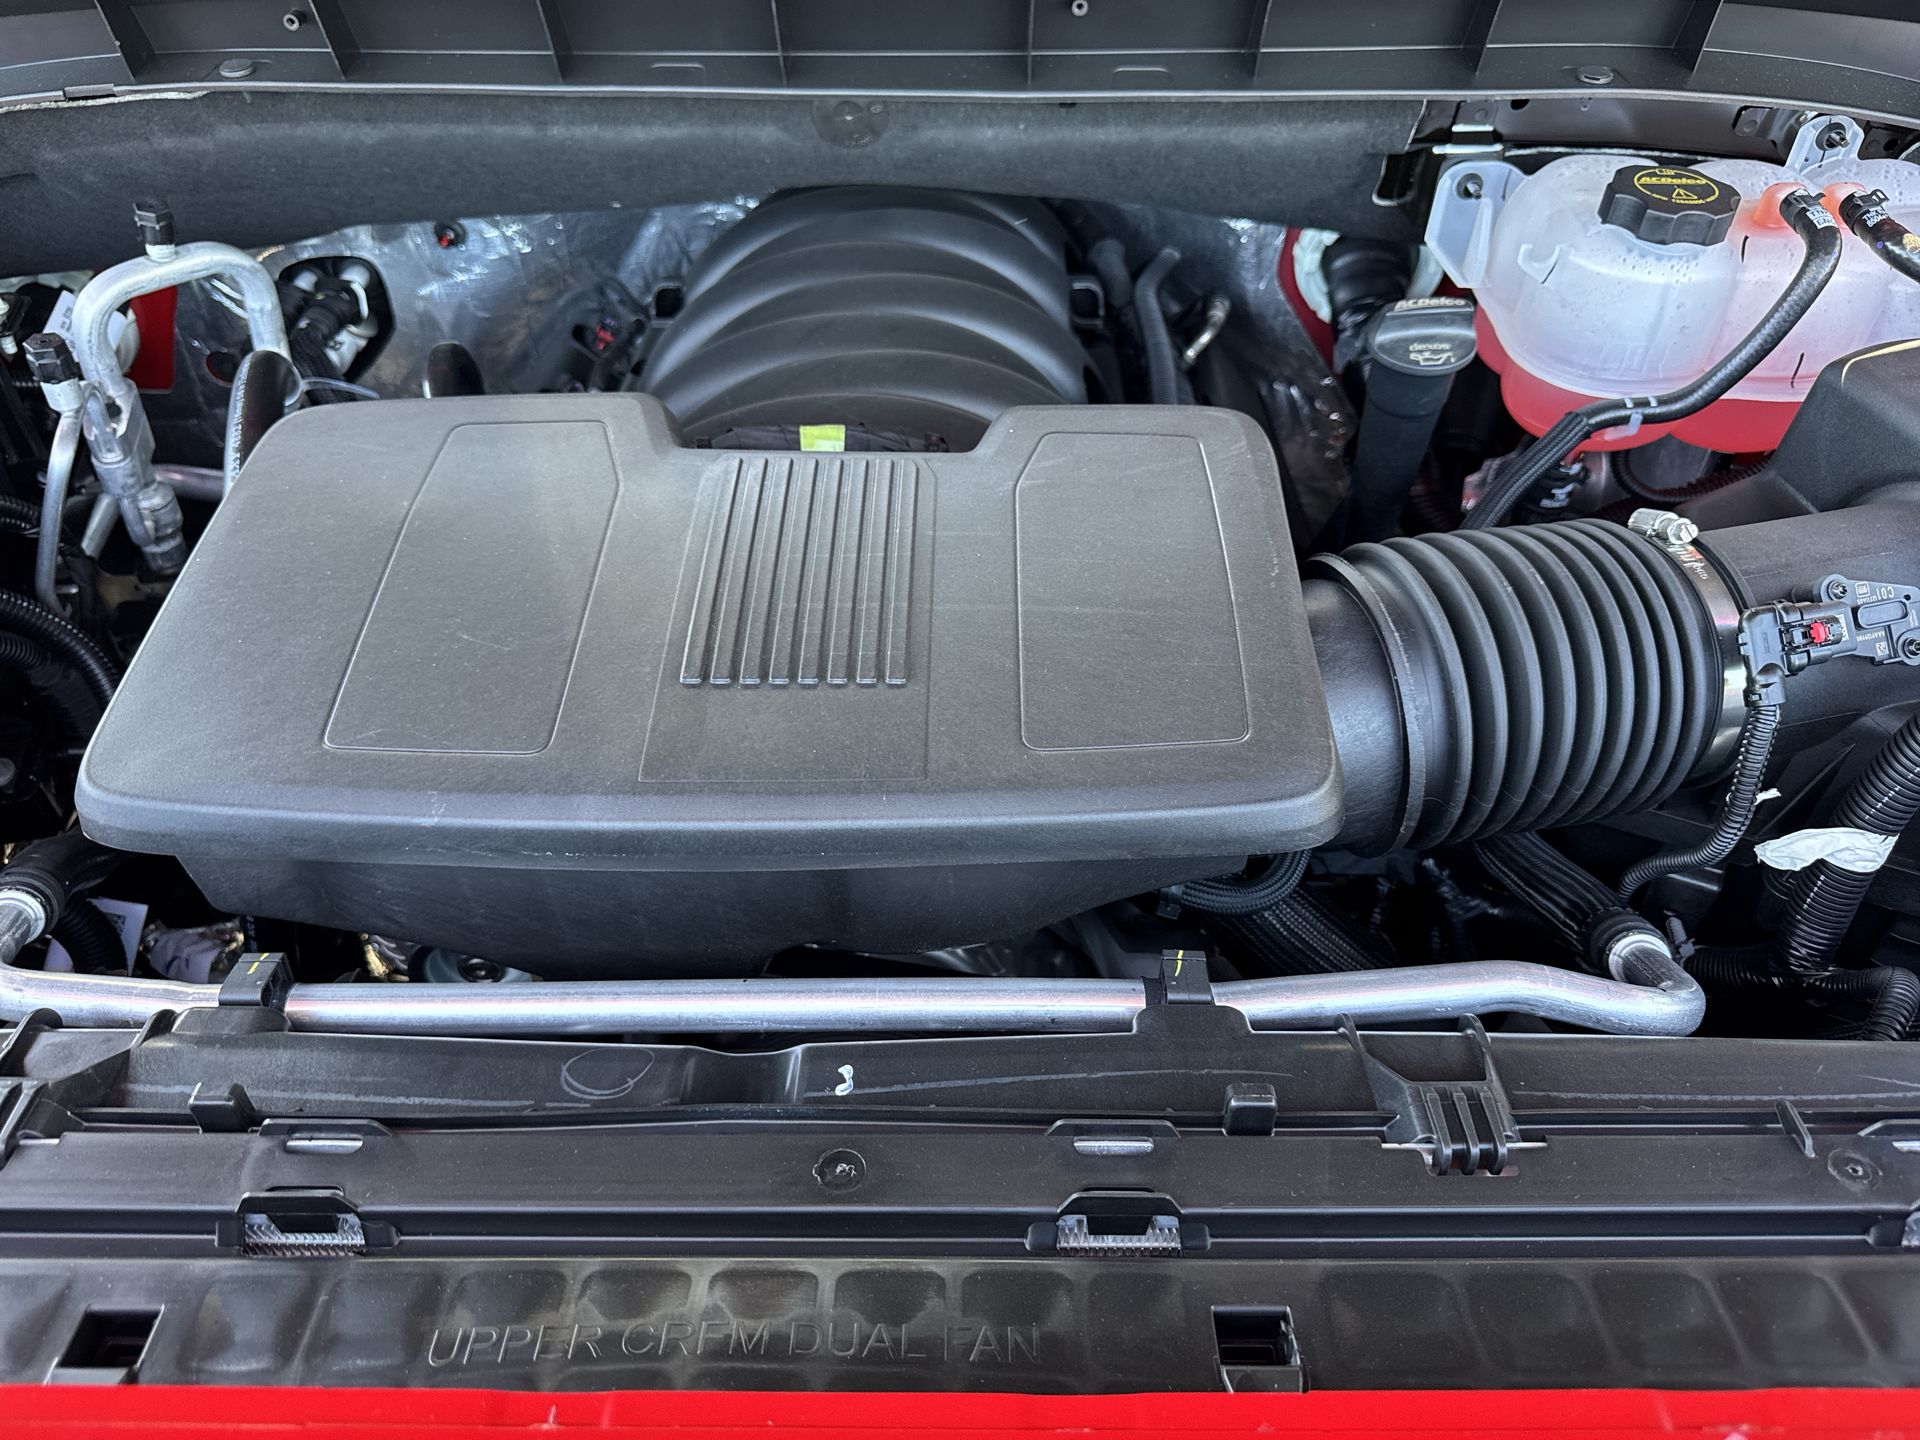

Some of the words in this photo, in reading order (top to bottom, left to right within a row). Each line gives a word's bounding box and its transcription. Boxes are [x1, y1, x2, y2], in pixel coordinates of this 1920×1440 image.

[1638, 176, 1706, 185] ACDelco
[1394, 297, 1466, 311] ACDelco
[1409, 343, 1452, 352] dexos
[428, 1323, 603, 1367] UPPER
[621, 1320, 770, 1357] CRFM
[787, 1321, 927, 1359] DUAL
[944, 1322, 1042, 1364] FAN
